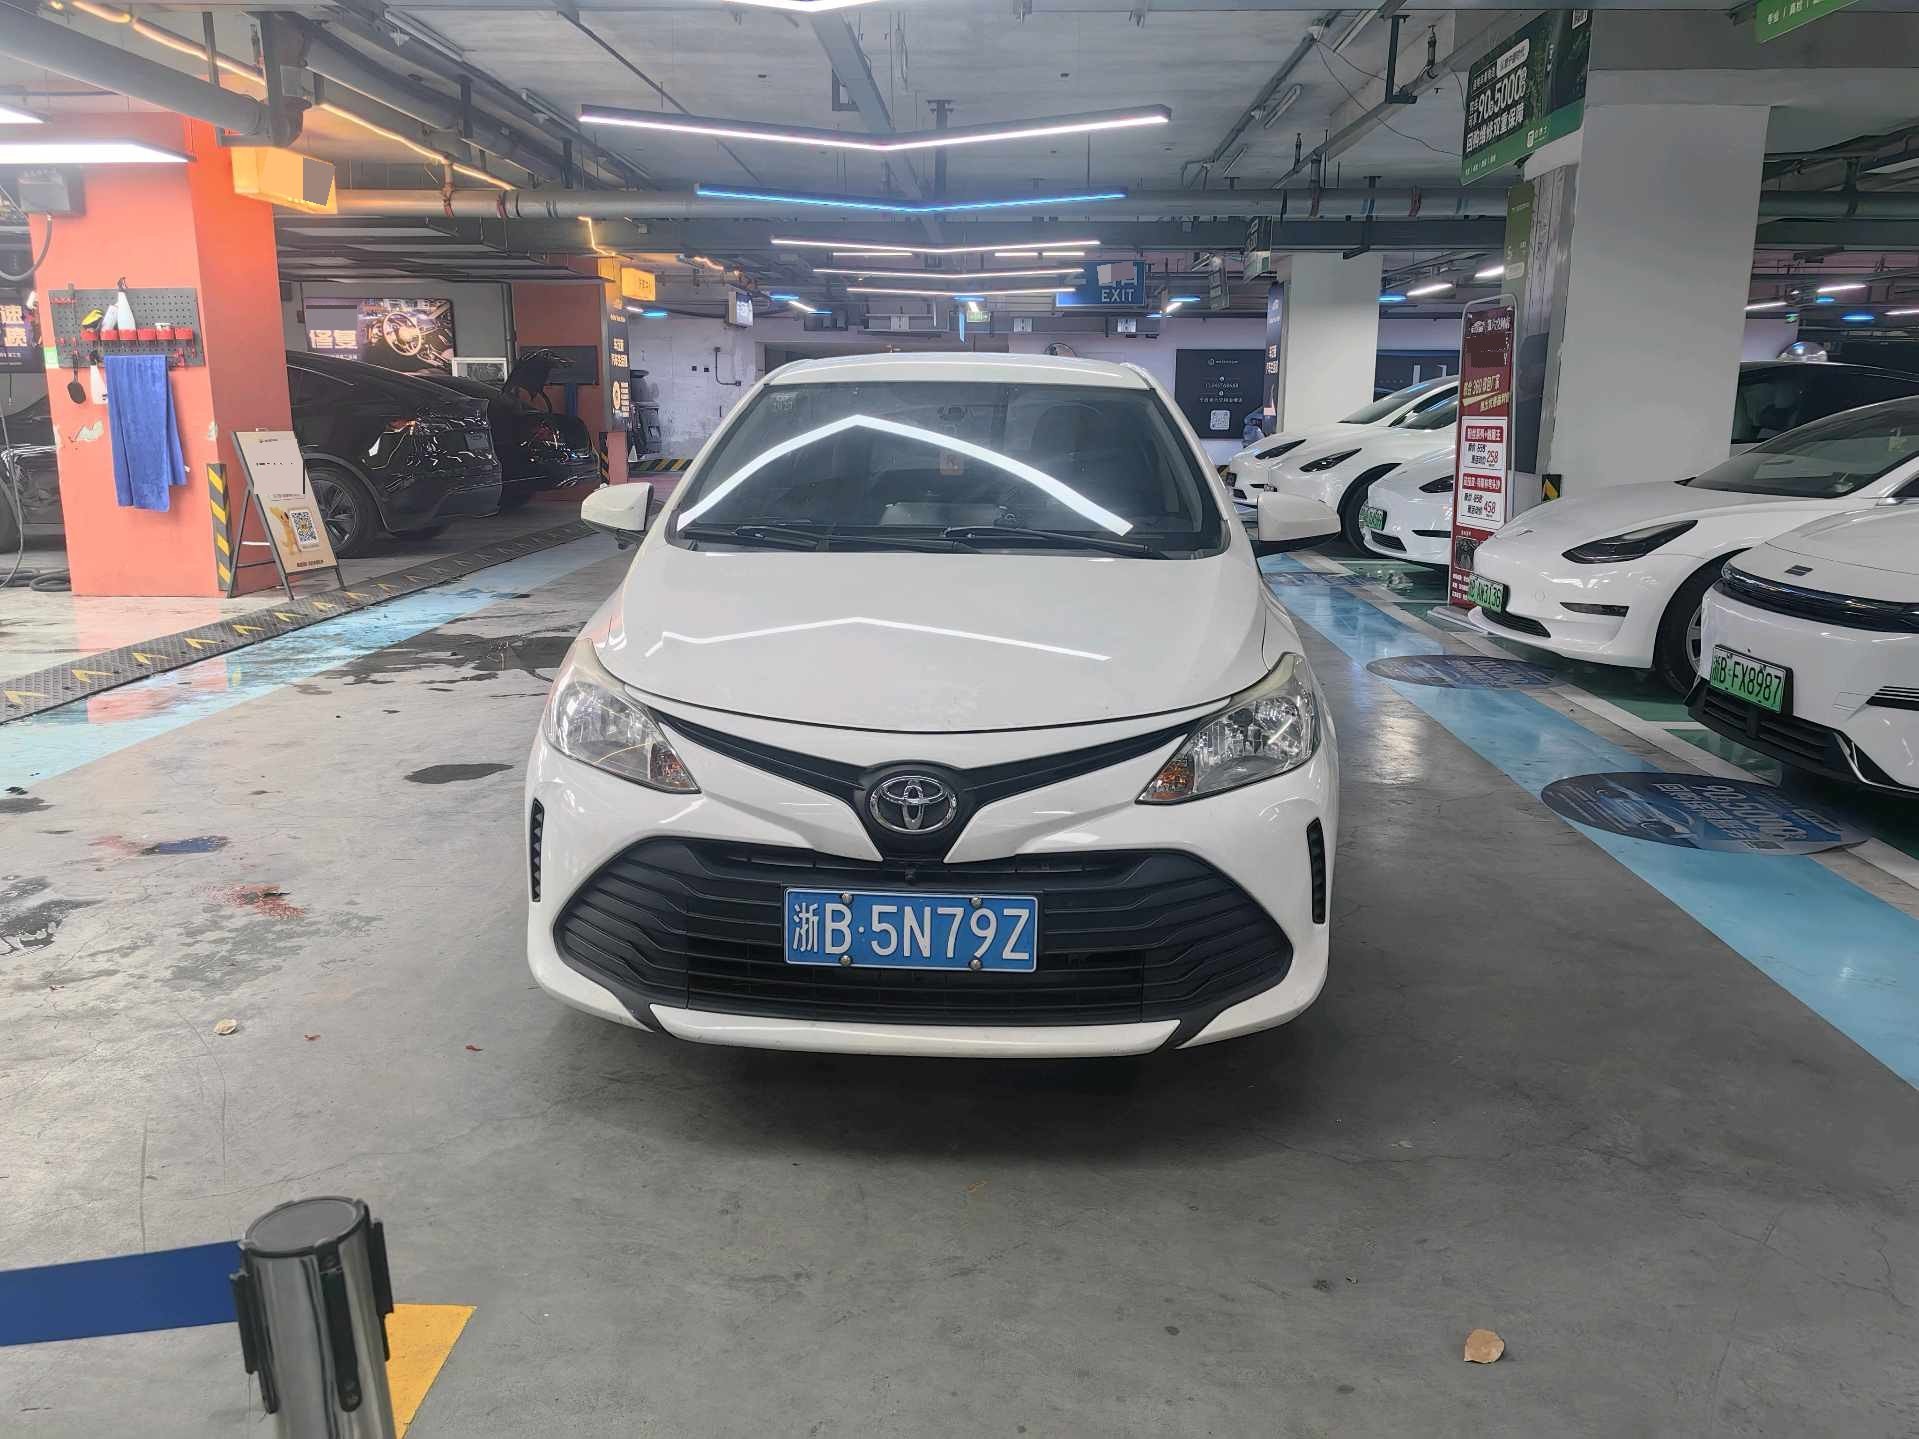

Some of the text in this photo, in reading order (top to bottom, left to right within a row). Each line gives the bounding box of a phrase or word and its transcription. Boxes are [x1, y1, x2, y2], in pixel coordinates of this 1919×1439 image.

[1101, 289, 1135, 302] EXIT
[1483, 500, 1497, 515] 458
[791, 902, 1030, 960] 浙B·5N79Z
